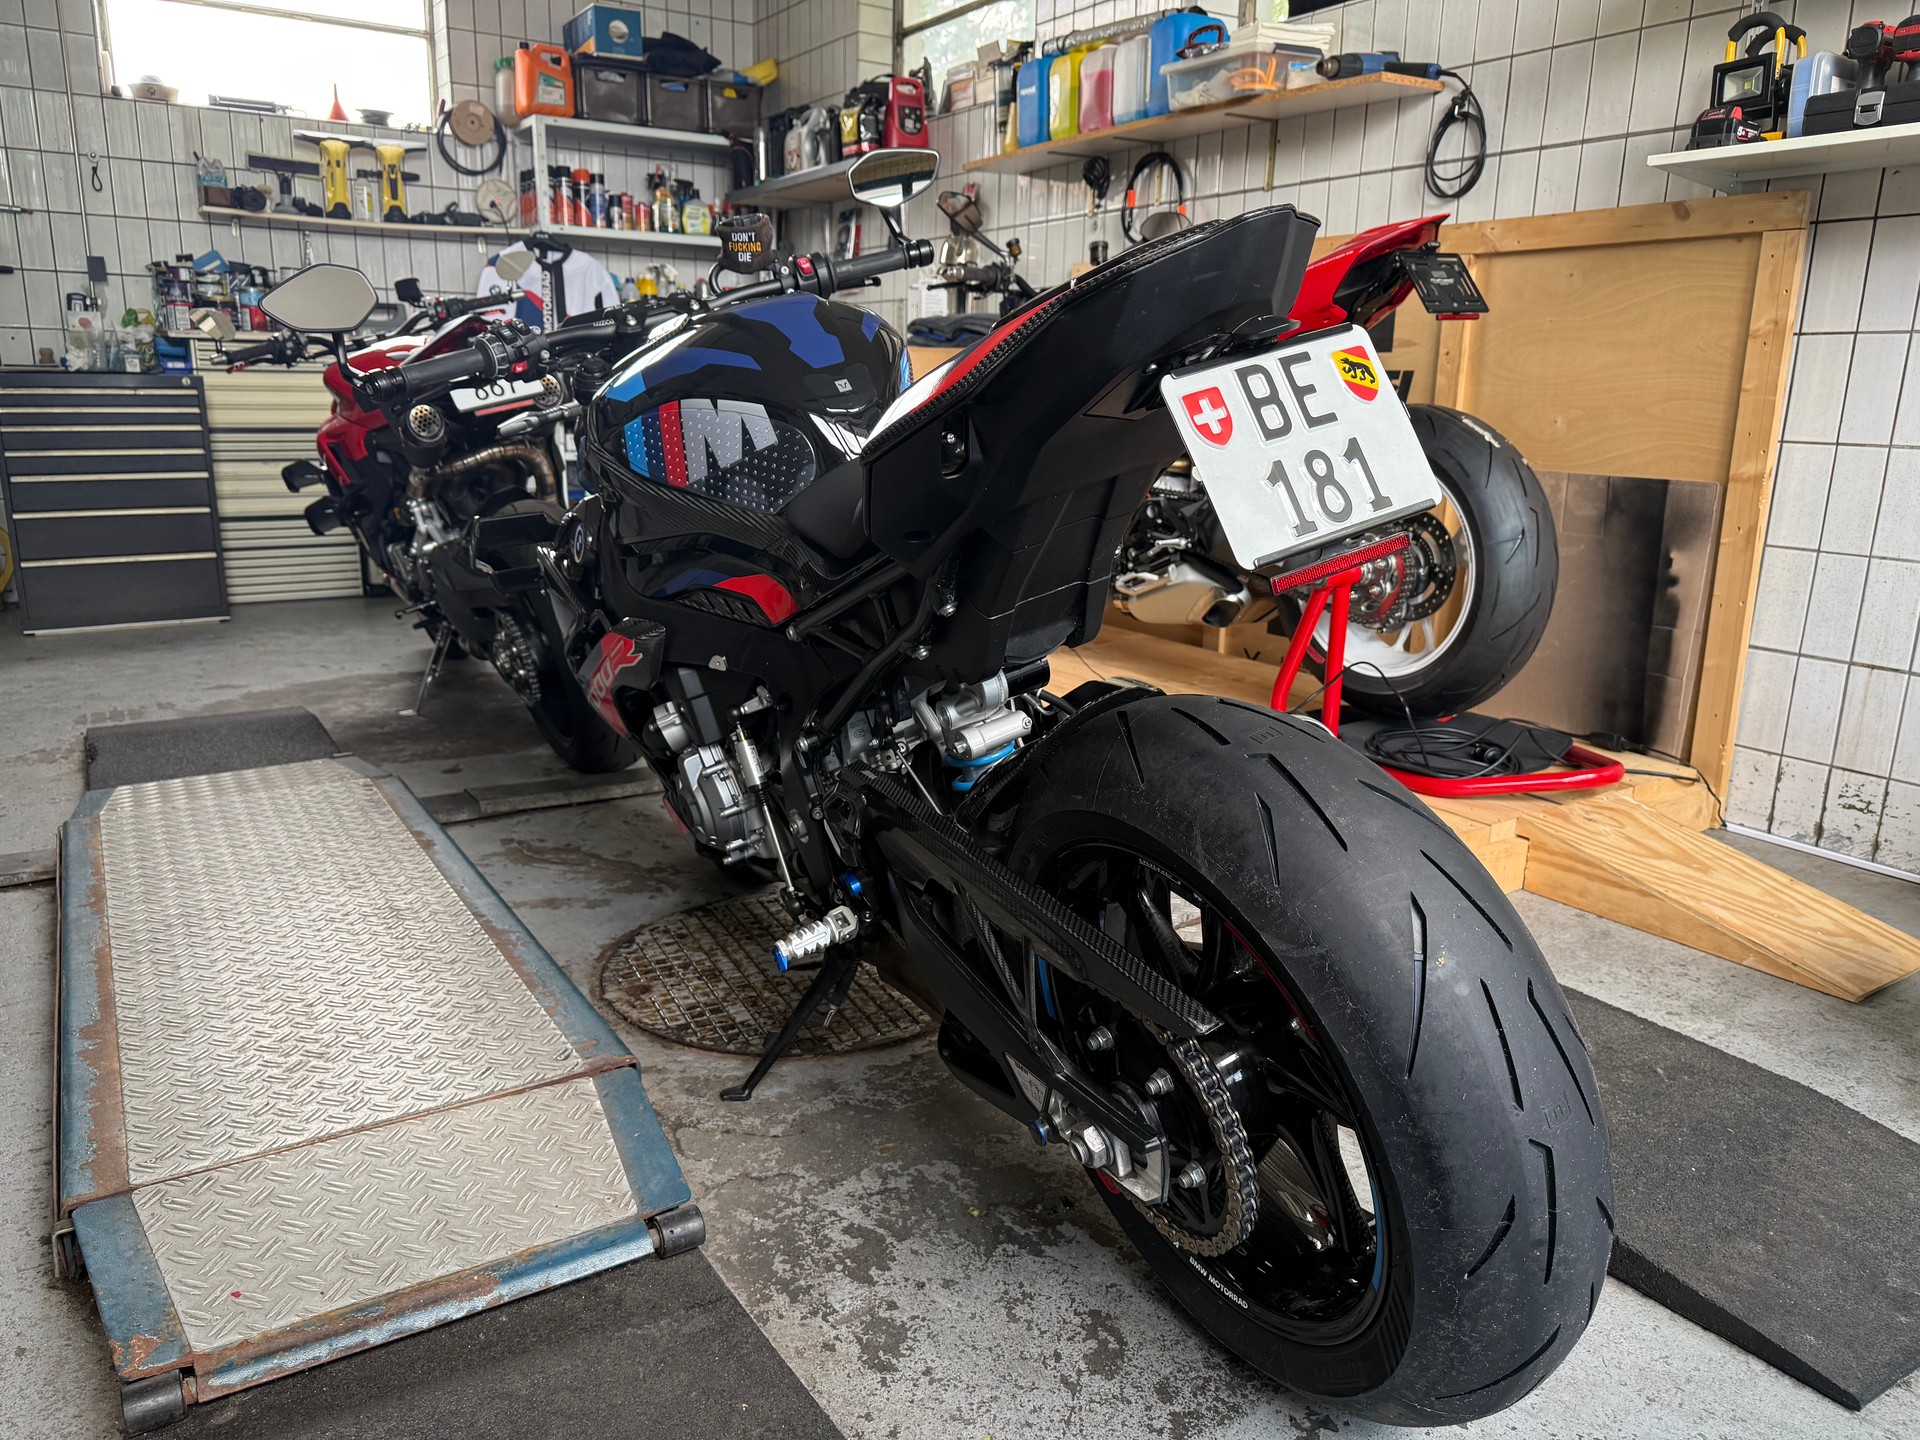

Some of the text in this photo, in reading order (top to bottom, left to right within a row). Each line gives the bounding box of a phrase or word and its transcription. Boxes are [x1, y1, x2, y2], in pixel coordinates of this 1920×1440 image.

[728, 241, 762, 252] FUCKING
[731, 232, 756, 242] DON'T
[738, 252, 752, 262] DIE
[1233, 350, 1339, 442] BE
[1265, 436, 1393, 538] 181
[1189, 1256, 1249, 1309] BMW MOTORRAD
